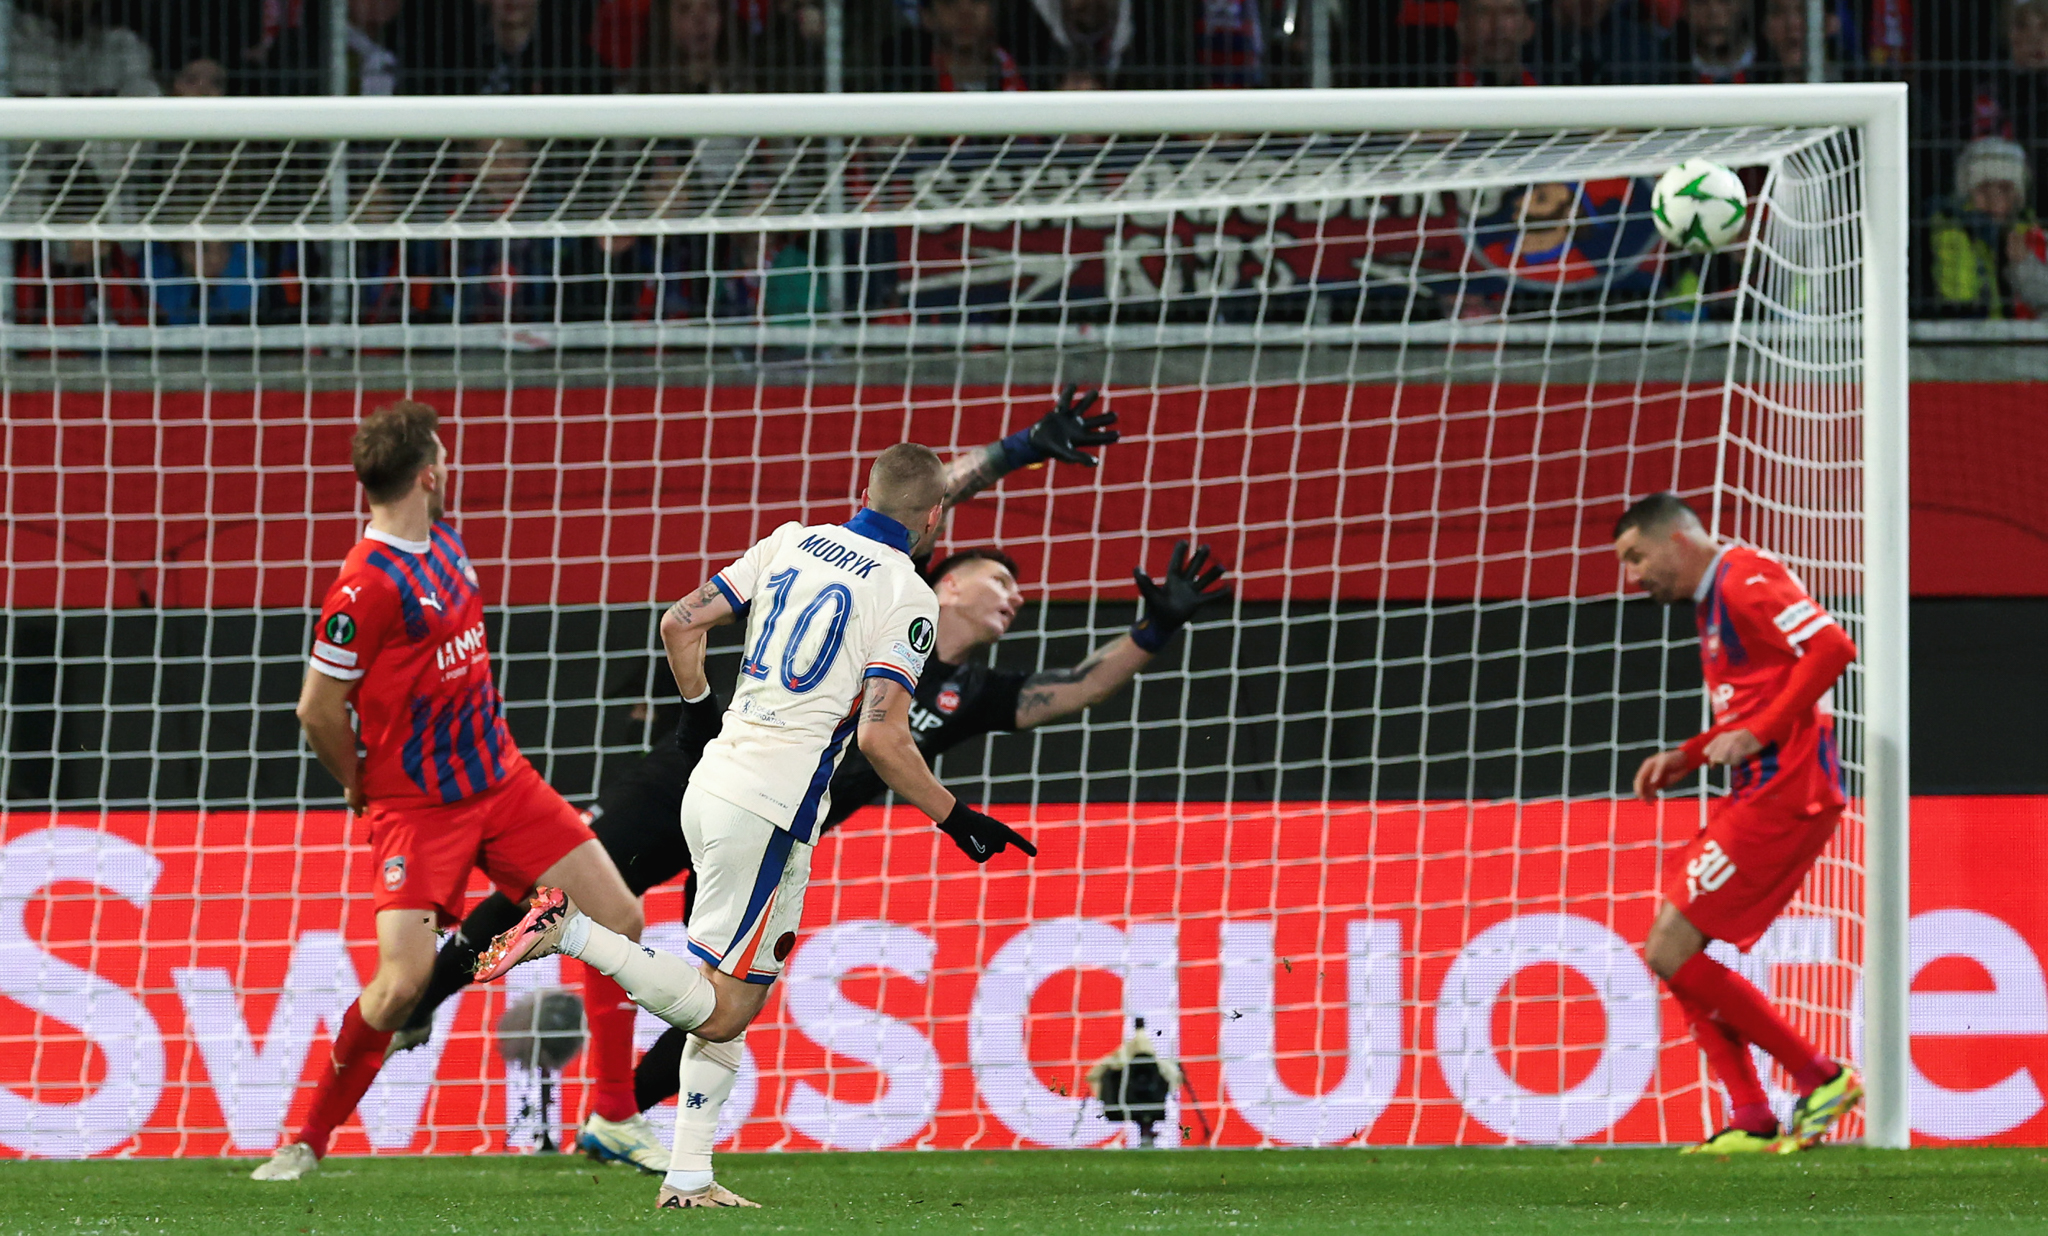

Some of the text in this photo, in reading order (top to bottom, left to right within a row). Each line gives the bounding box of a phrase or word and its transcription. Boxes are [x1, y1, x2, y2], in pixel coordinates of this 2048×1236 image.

[797, 533, 882, 579] MUDRYK
[740, 564, 854, 695] 10
[1686, 839, 1737, 892] 30
